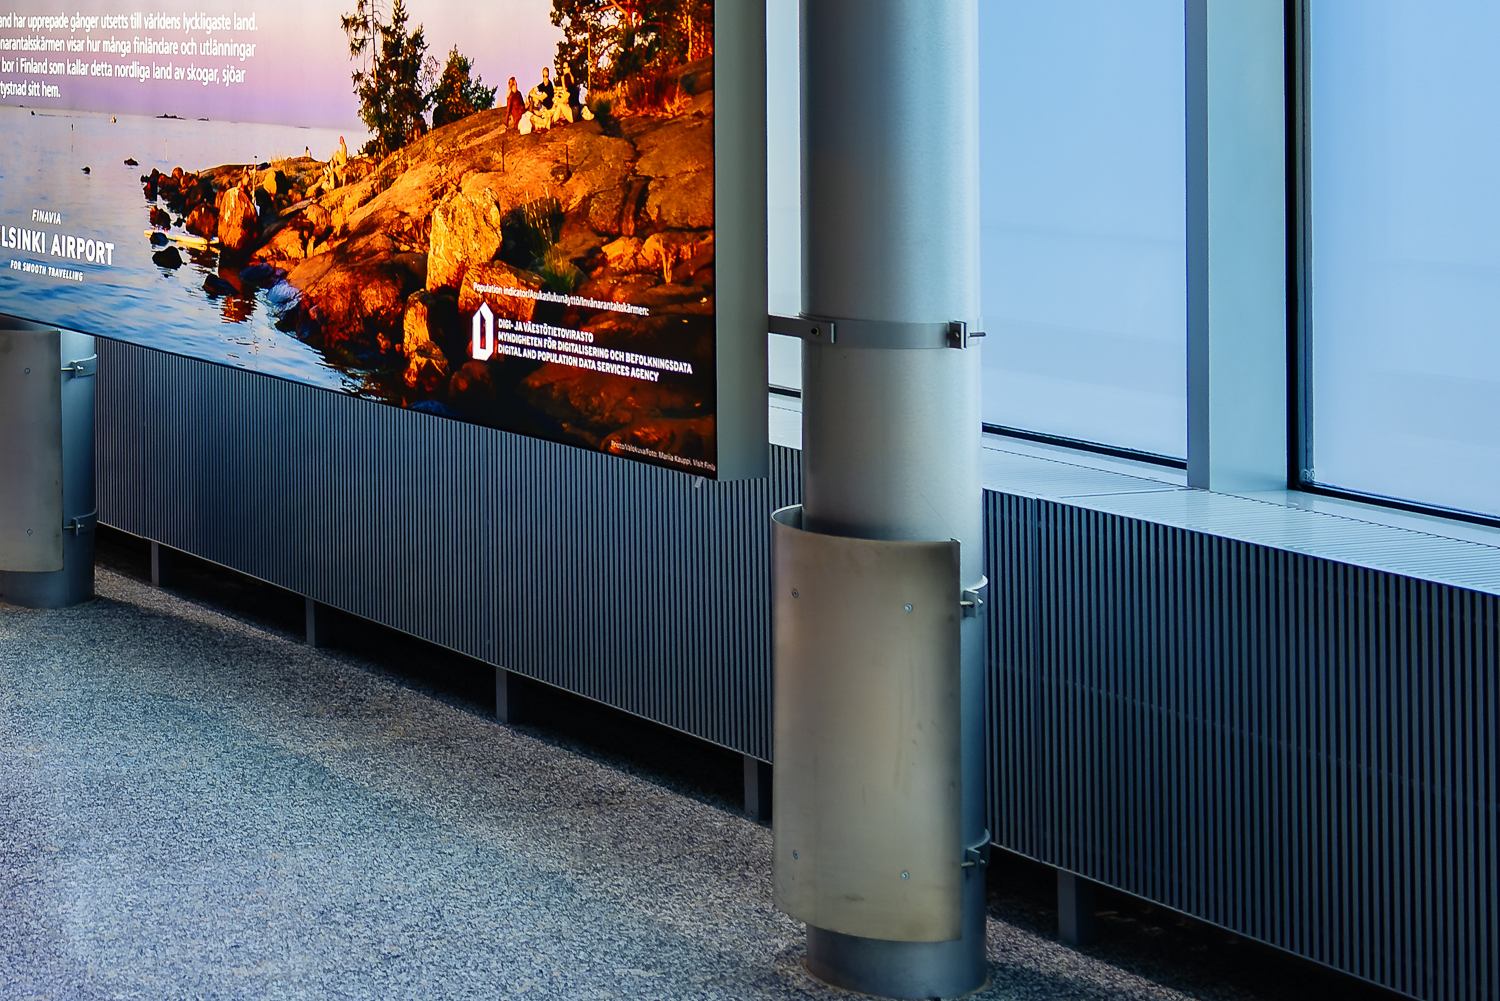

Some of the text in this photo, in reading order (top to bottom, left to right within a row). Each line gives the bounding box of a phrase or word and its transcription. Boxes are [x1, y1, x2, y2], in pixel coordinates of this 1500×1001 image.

[13, 11, 27, 28] har
[27, 11, 69, 33] upprepade
[69, 11, 99, 33] gånger
[100, 13, 129, 29] utsetts
[129, 11, 142, 29] till
[143, 11, 181, 31] världens
[182, 11, 231, 35] lyckligaste
[233, 11, 258, 31] land.
[65, 34, 86, 55] visar
[86, 34, 102, 52] hur
[102, 34, 131, 58] många
[132, 35, 179, 56] finländare
[179, 36, 197, 56] och
[199, 37, 256, 62] utlänningar
[1, 56, 15, 73] bor
[15, 56, 19, 73] i
[19, 56, 48, 75] Finland
[48, 61, 65, 75] som
[66, 57, 90, 76] kallar
[90, 58, 113, 77] detta
[114, 60, 151, 83] nordliga
[152, 61, 172, 80] land
[173, 66, 185, 80] av
[186, 62, 220, 86] skogar,
[221, 64, 246, 87] sjöar
[27, 79, 41, 97] sitt
[41, 80, 61, 98] hem.
[32, 209, 62, 225] FINAVIA
[51, 233, 115, 265] AIRPORT
[10, 260, 84, 282] FOR SMOOTH TRAVELLING
[472, 281, 502, 295] Population
[497, 317, 594, 343] DIGI- JA VÄESTÖTIETOVIRASTO
[497, 330, 693, 375] MYNDIGHETEN FÖR DIGITALISERING OCH BEFOLKNINGSDATA
[497, 343, 659, 383] DIGITAL AND POPULATION DATA SERVICES AGENCY
